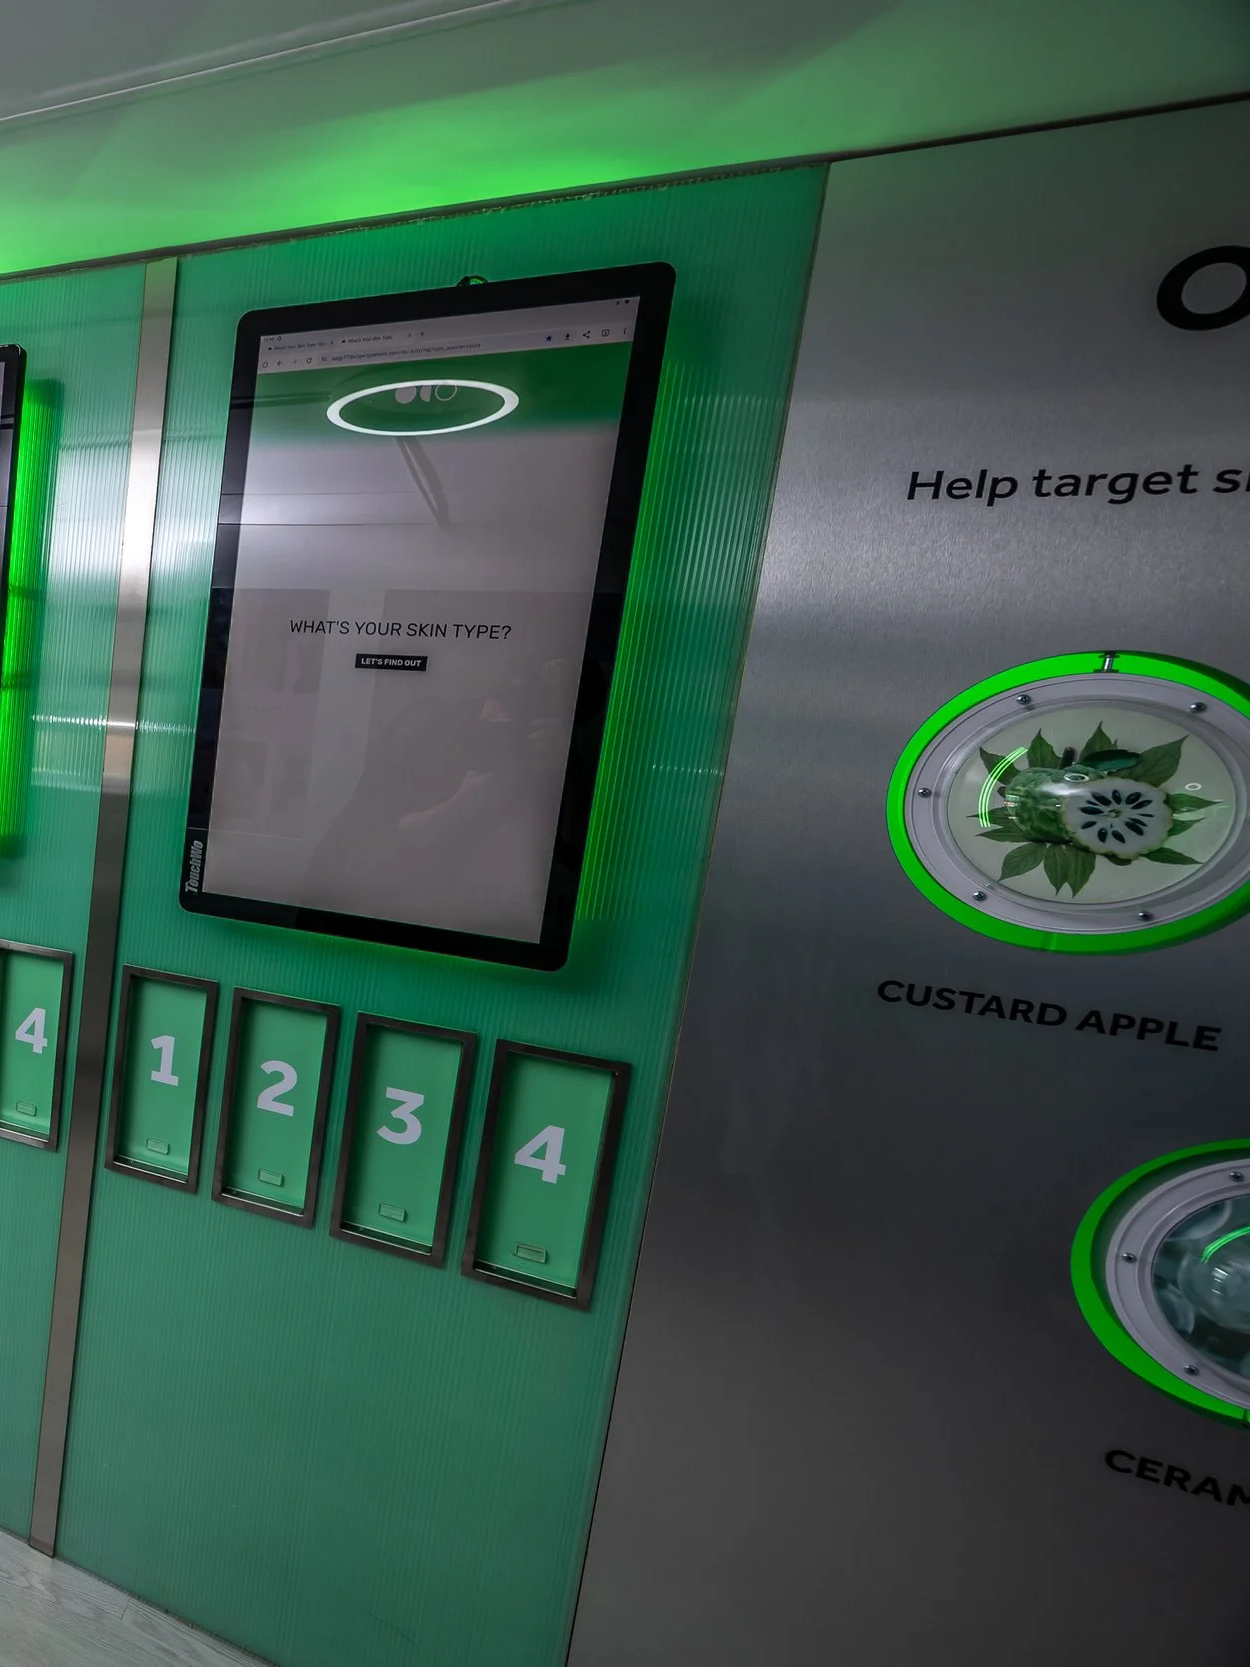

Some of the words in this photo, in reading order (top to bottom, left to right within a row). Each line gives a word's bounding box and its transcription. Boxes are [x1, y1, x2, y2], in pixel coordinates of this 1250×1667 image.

[907, 469, 1018, 507] Help
[1032, 464, 1201, 504] target
[1212, 468, 1250, 494] s
[290, 619, 350, 635] WHAT'S
[354, 621, 401, 636] YOUR
[406, 623, 447, 638] SKIN
[452, 624, 512, 640] TYPE?
[361, 657, 383, 665] LET'S
[384, 658, 403, 666] FIND
[404, 659, 422, 667] OUT
[15, 1007, 48, 1054] 4
[877, 980, 1067, 1027] CUSTARD
[1075, 1010, 1222, 1052] APPLE
[150, 1035, 179, 1087] 1
[256, 1060, 298, 1117] 2
[376, 1087, 425, 1145] 3
[514, 1125, 566, 1185] 4
